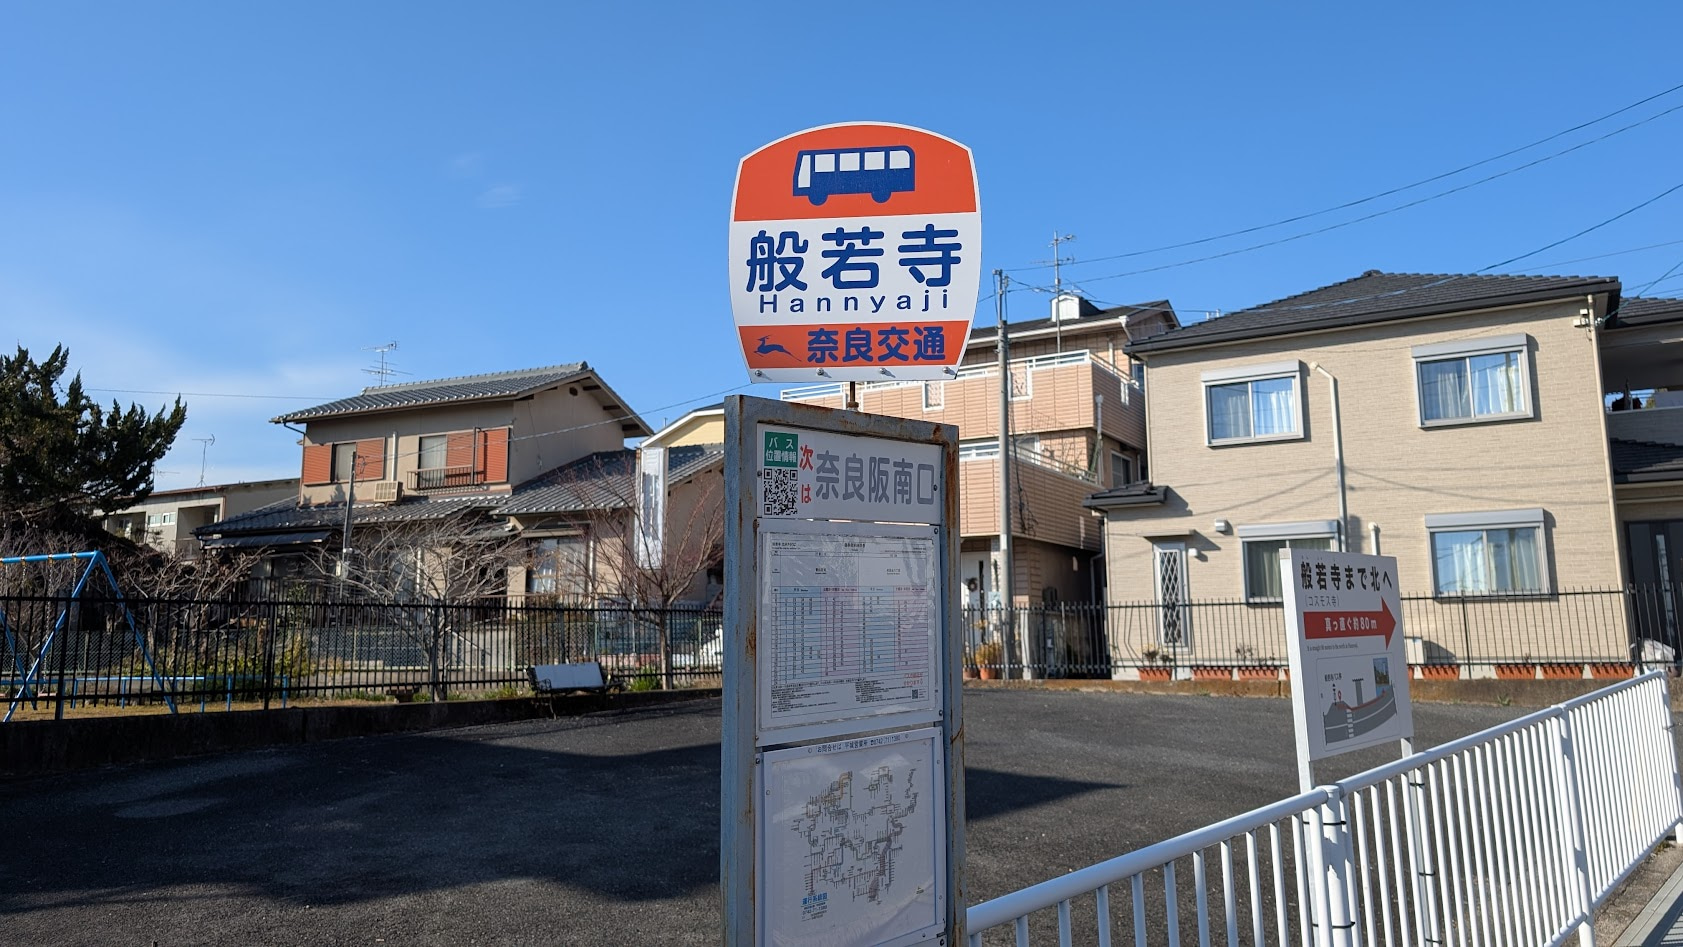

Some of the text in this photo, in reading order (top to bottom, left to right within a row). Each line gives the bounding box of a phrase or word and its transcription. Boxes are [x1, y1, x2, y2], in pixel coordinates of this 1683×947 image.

[746, 223, 962, 292] 般若寺
[759, 289, 948, 313] Hannyaji
[807, 326, 946, 363] 奈良交通
[765, 449, 797, 463] 位置情報
[768, 437, 794, 450] バス
[815, 450, 935, 505] 奈良阪南口
[1301, 561, 1392, 591] 般若寺まで北へ
